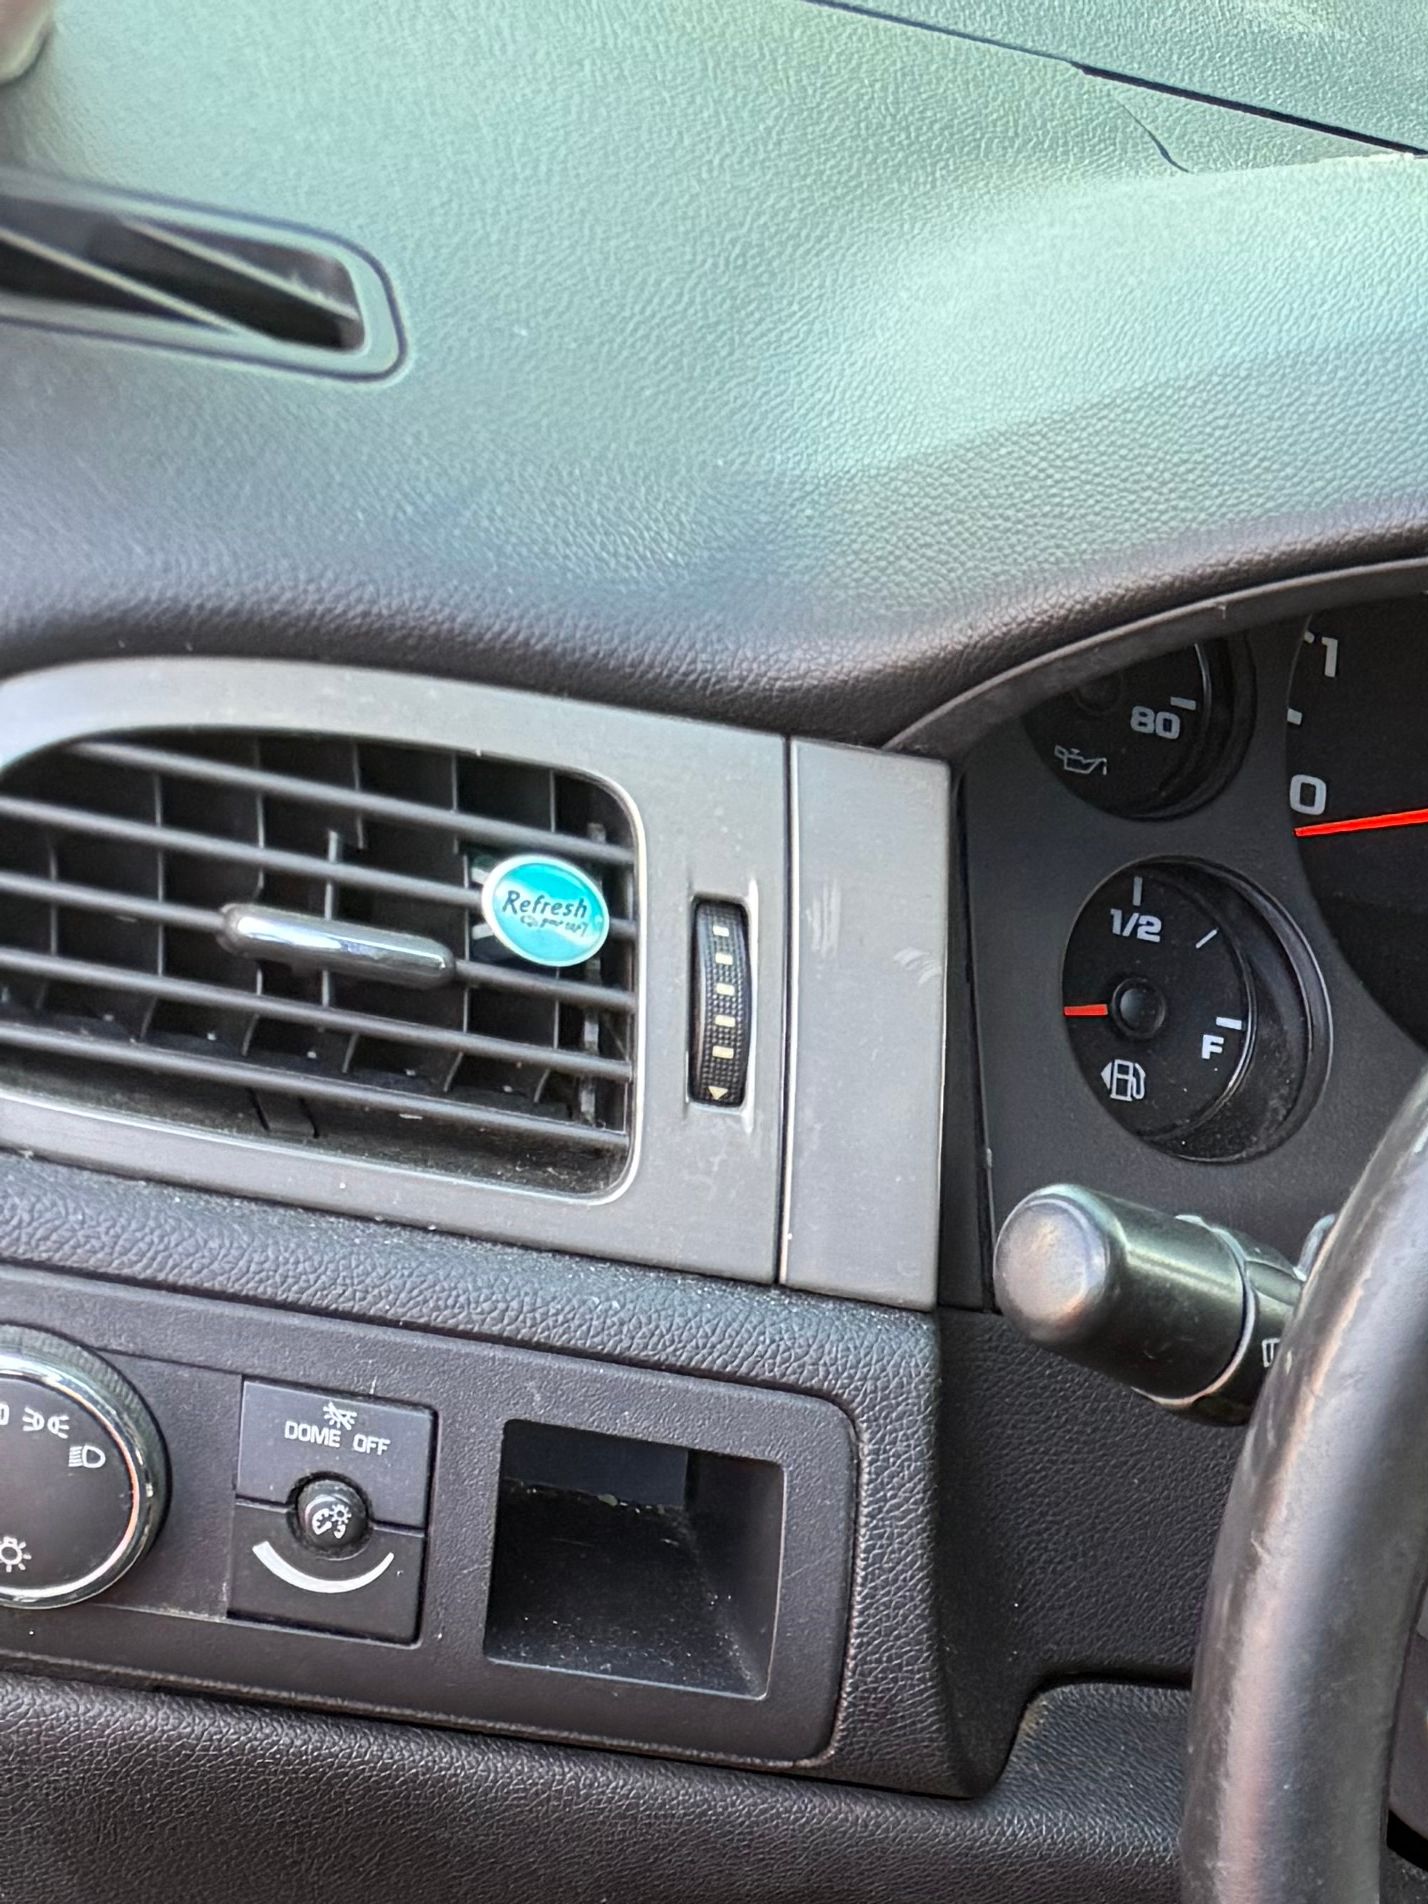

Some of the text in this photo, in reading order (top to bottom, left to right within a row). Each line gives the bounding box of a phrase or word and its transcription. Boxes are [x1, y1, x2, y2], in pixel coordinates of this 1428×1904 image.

[1321, 636, 1338, 678] 1
[1130, 705, 1181, 739] 80
[1289, 774, 1327, 816] 0
[502, 889, 587, 919] Refresh
[1110, 908, 1162, 943] 1/2
[1201, 1034, 1225, 1060] F
[284, 1420, 391, 1455] DOME OFF
